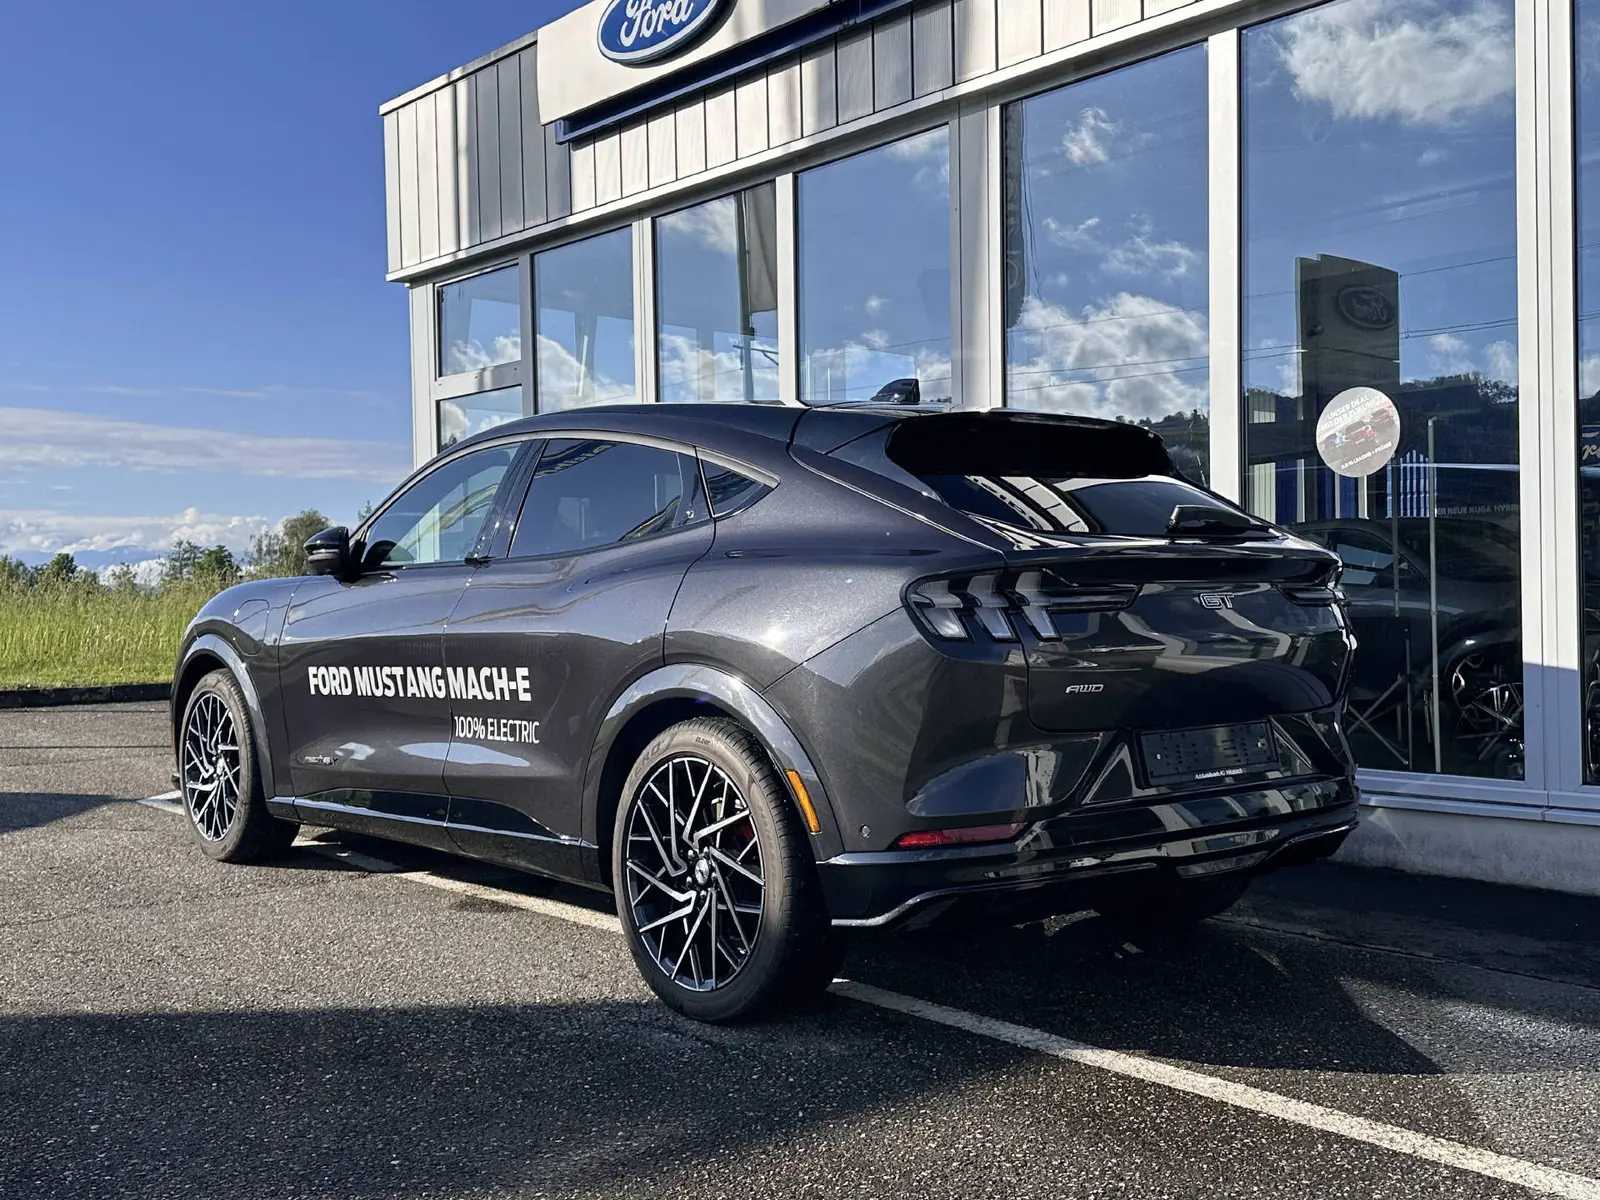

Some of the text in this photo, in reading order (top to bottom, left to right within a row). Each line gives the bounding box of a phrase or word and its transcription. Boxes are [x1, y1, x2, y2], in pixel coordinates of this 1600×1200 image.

[620, 0, 694, 47] Ford
[1494, 502, 1519, 513] HYBRI
[1200, 593, 1234, 609] GT
[308, 666, 532, 701] FORD MUSTANG MACH-E
[1066, 684, 1104, 693] AWD
[454, 716, 540, 744] 100% ELECTRIC
